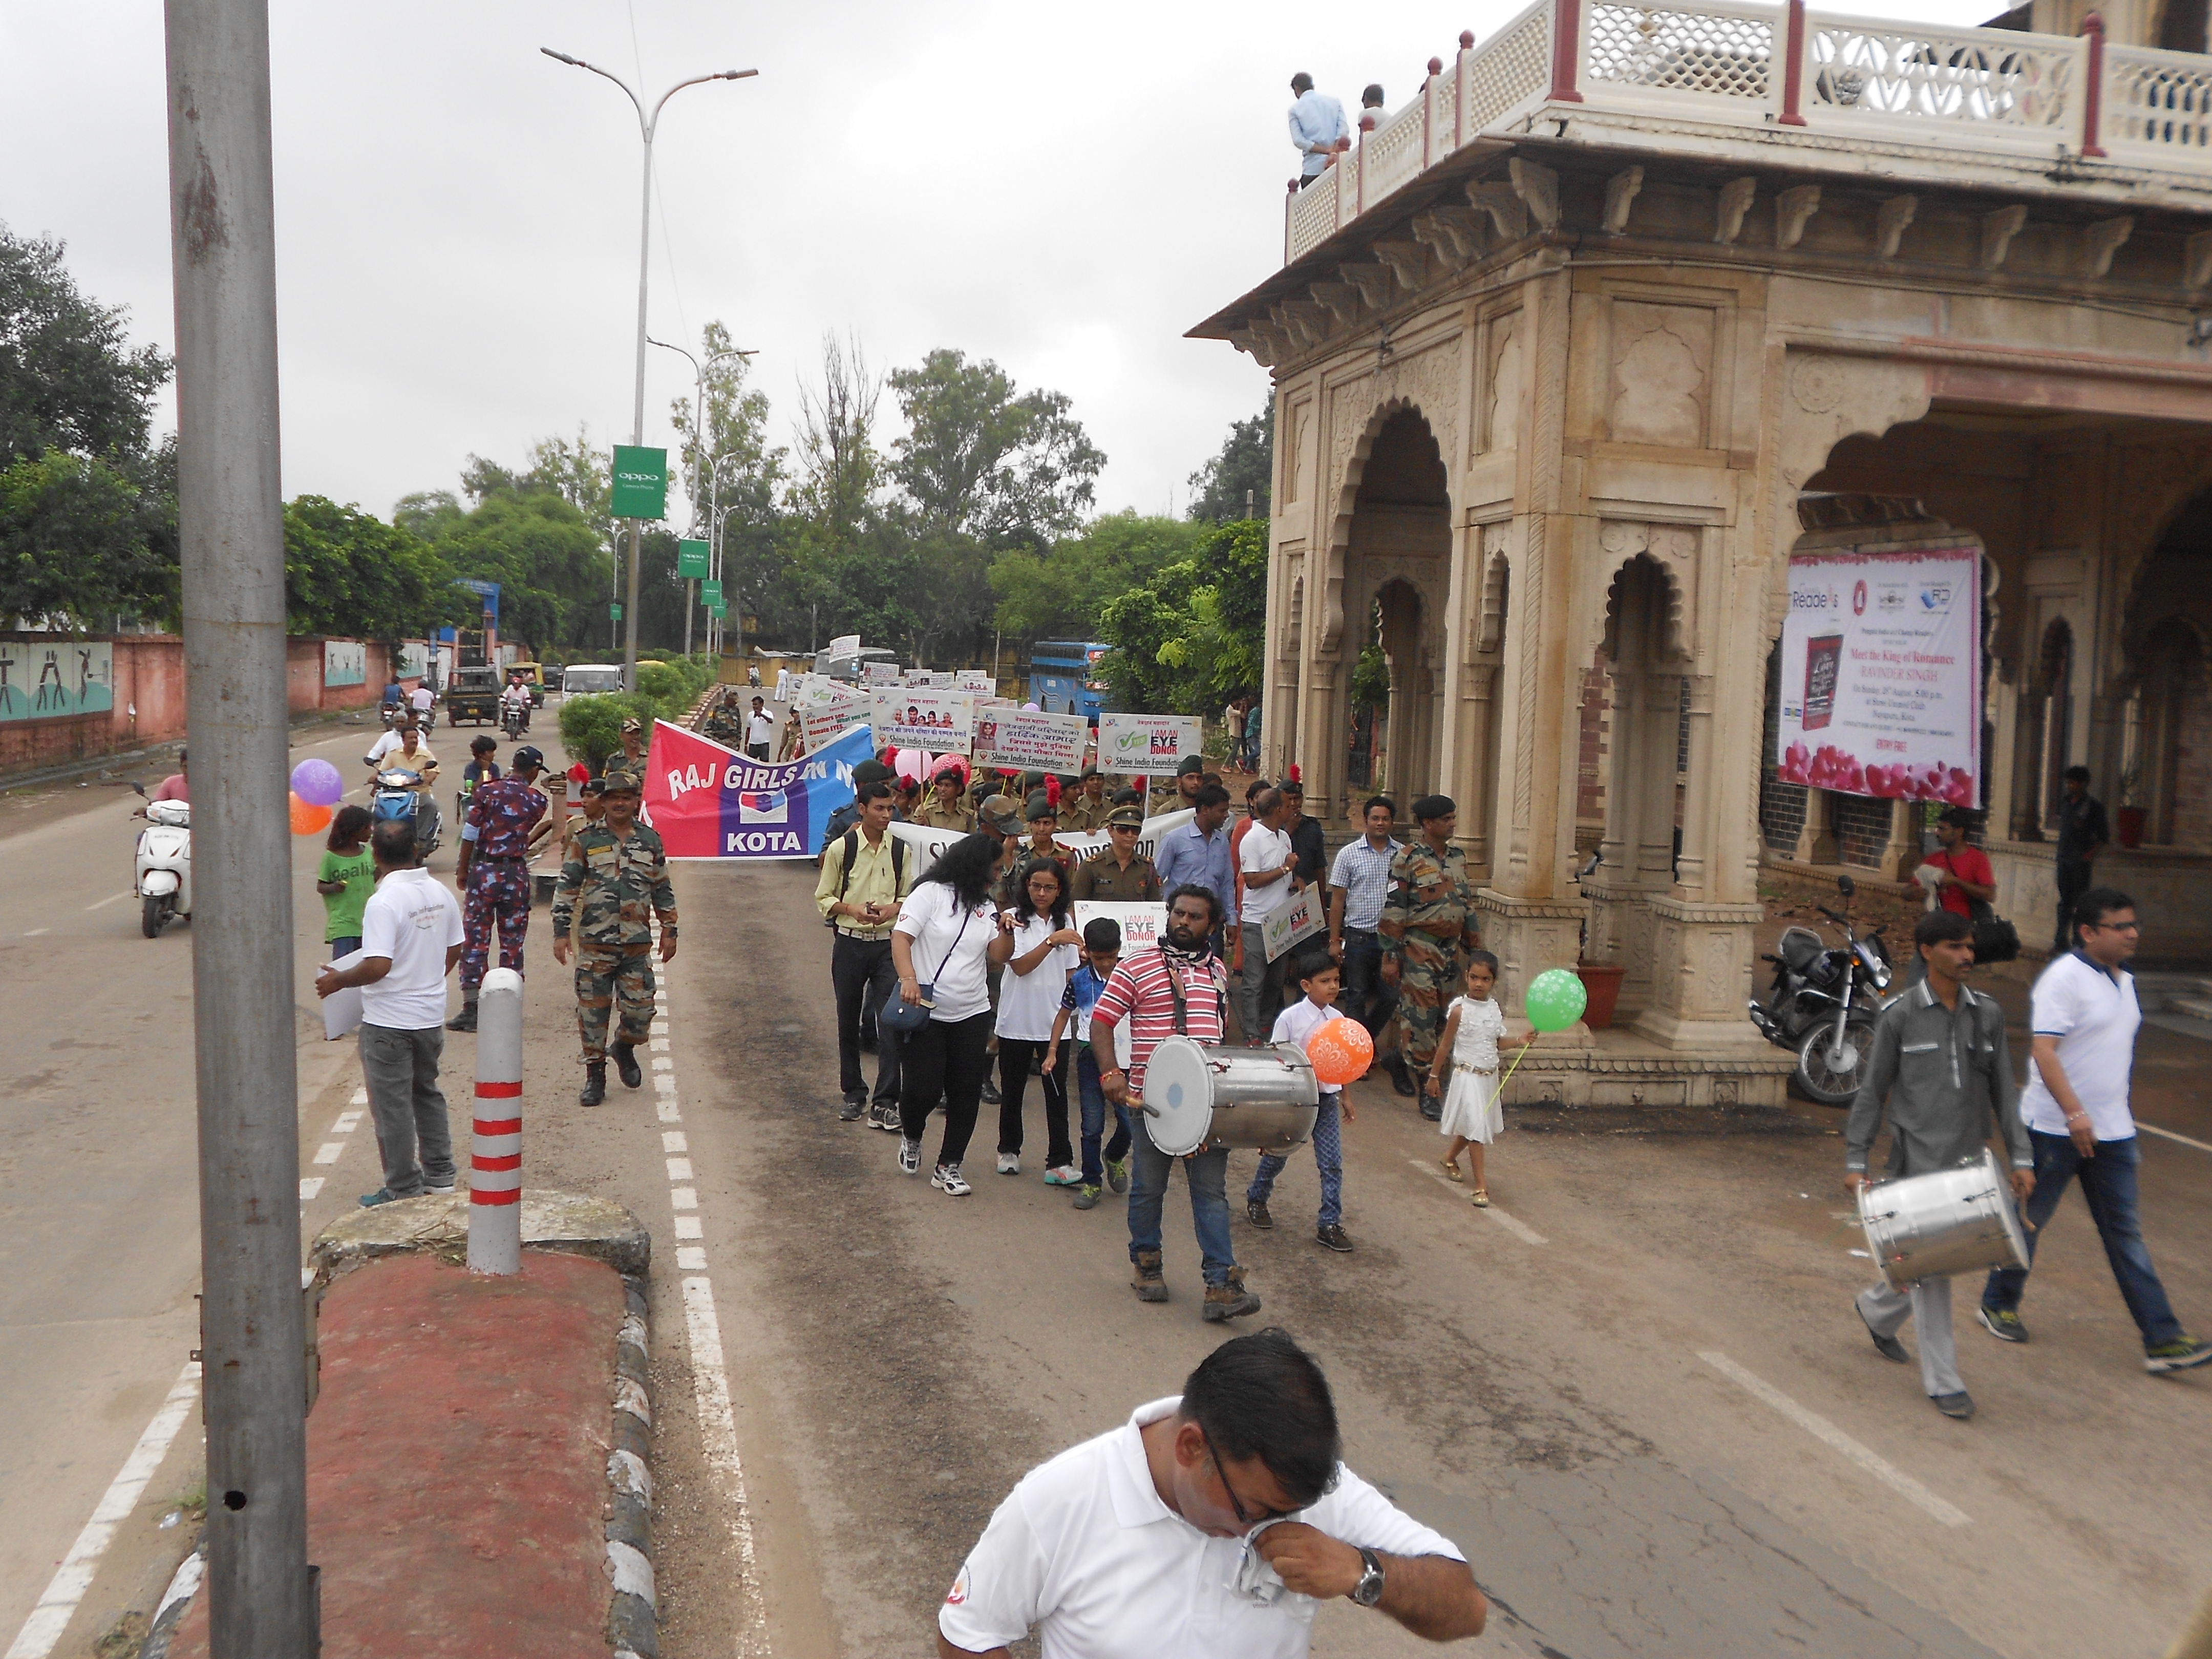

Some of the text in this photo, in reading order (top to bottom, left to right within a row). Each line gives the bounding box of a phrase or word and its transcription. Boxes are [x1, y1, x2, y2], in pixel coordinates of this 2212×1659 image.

[1851, 648, 1955, 665] Meet the King of Romance
[1861, 666, 1938, 682] RAVINDER SINGH
[816, 715, 834, 724] others
[809, 727, 830, 736] Donate
[889, 735, 905, 745] Shine
[907, 737, 921, 746] India
[923, 737, 954, 748] Foundation
[1151, 736, 1178, 746] EYE
[1876, 738, 1907, 753] ENTRY FREE
[1150, 746, 1177, 755] DONOR
[991, 753, 1008, 761] Shine
[1010, 754, 1026, 762] India
[1028, 756, 1063, 767] Foundation
[1116, 757, 1133, 765] Shine
[1135, 758, 1150, 766] India
[668, 763, 716, 800] RAJ
[724, 765, 797, 789] GIRLS
[727, 832, 801, 852] KOTA
[1290, 907, 1308, 925] EYE
[1125, 922, 1155, 932] EYE
[1126, 932, 1156, 941] DONOR
